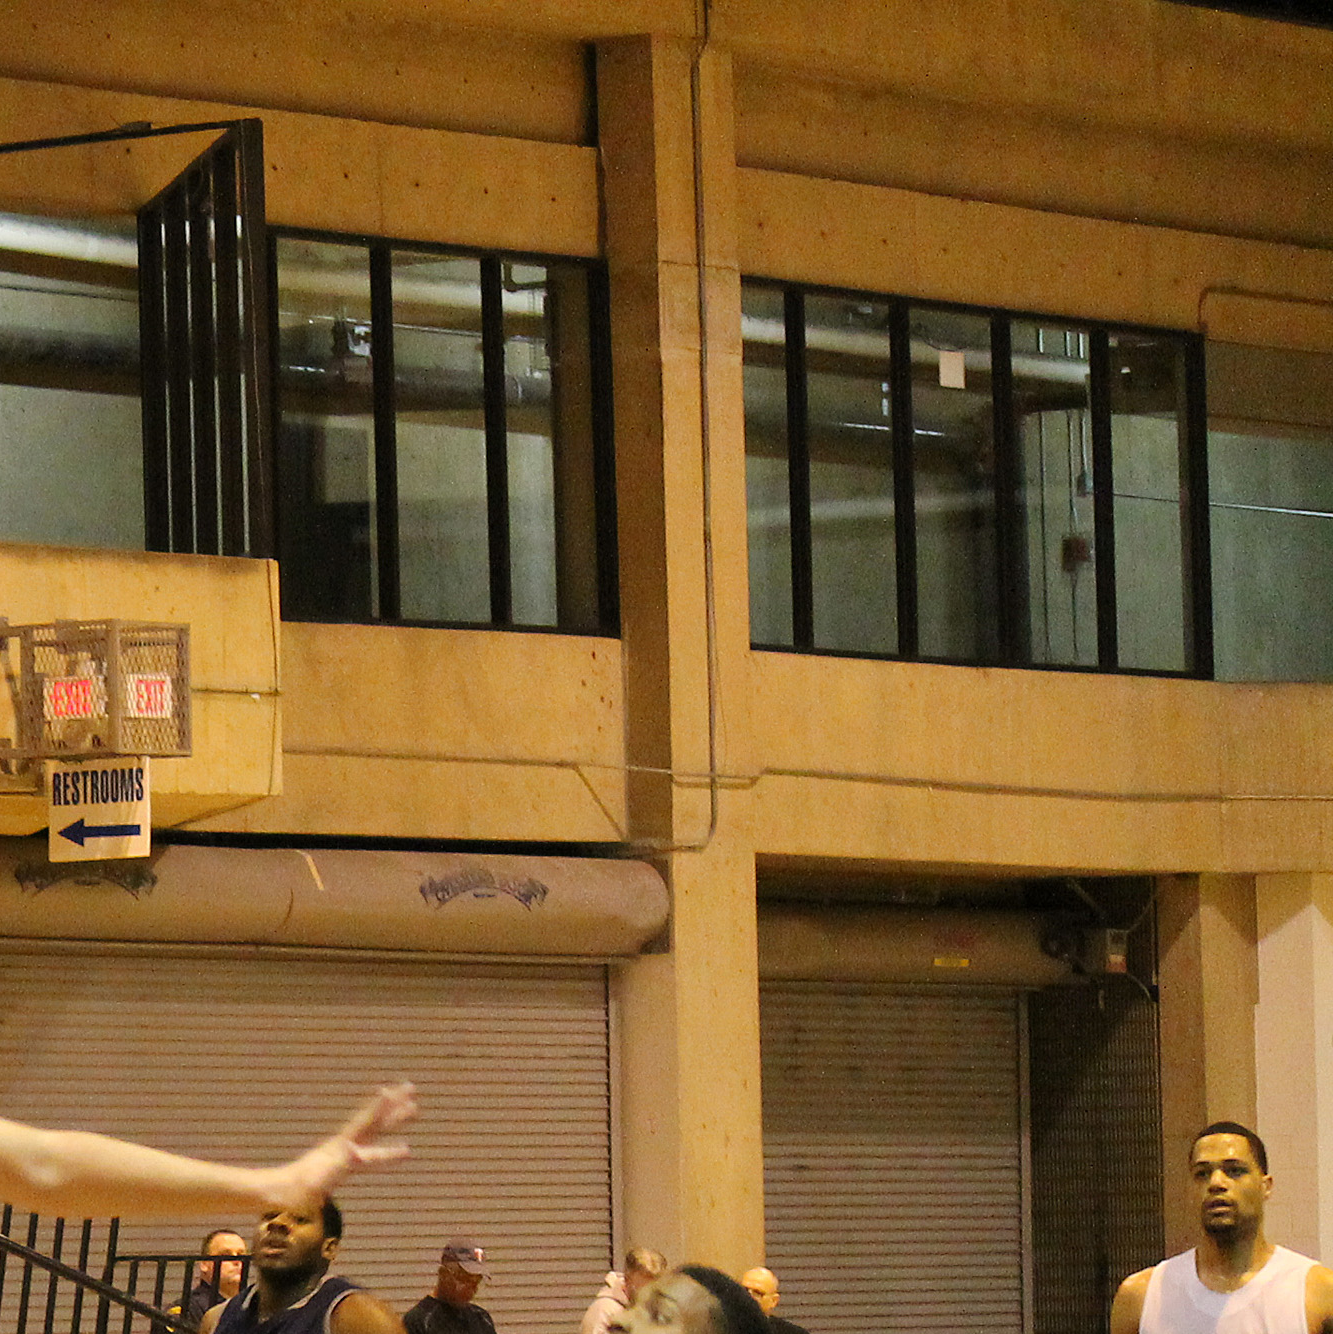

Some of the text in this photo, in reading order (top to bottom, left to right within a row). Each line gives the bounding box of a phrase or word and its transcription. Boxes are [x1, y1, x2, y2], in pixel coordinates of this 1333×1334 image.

[52, 680, 92, 716] EXIT
[136, 680, 166, 713] EXIT
[52, 767, 144, 806] RESTROOMS
